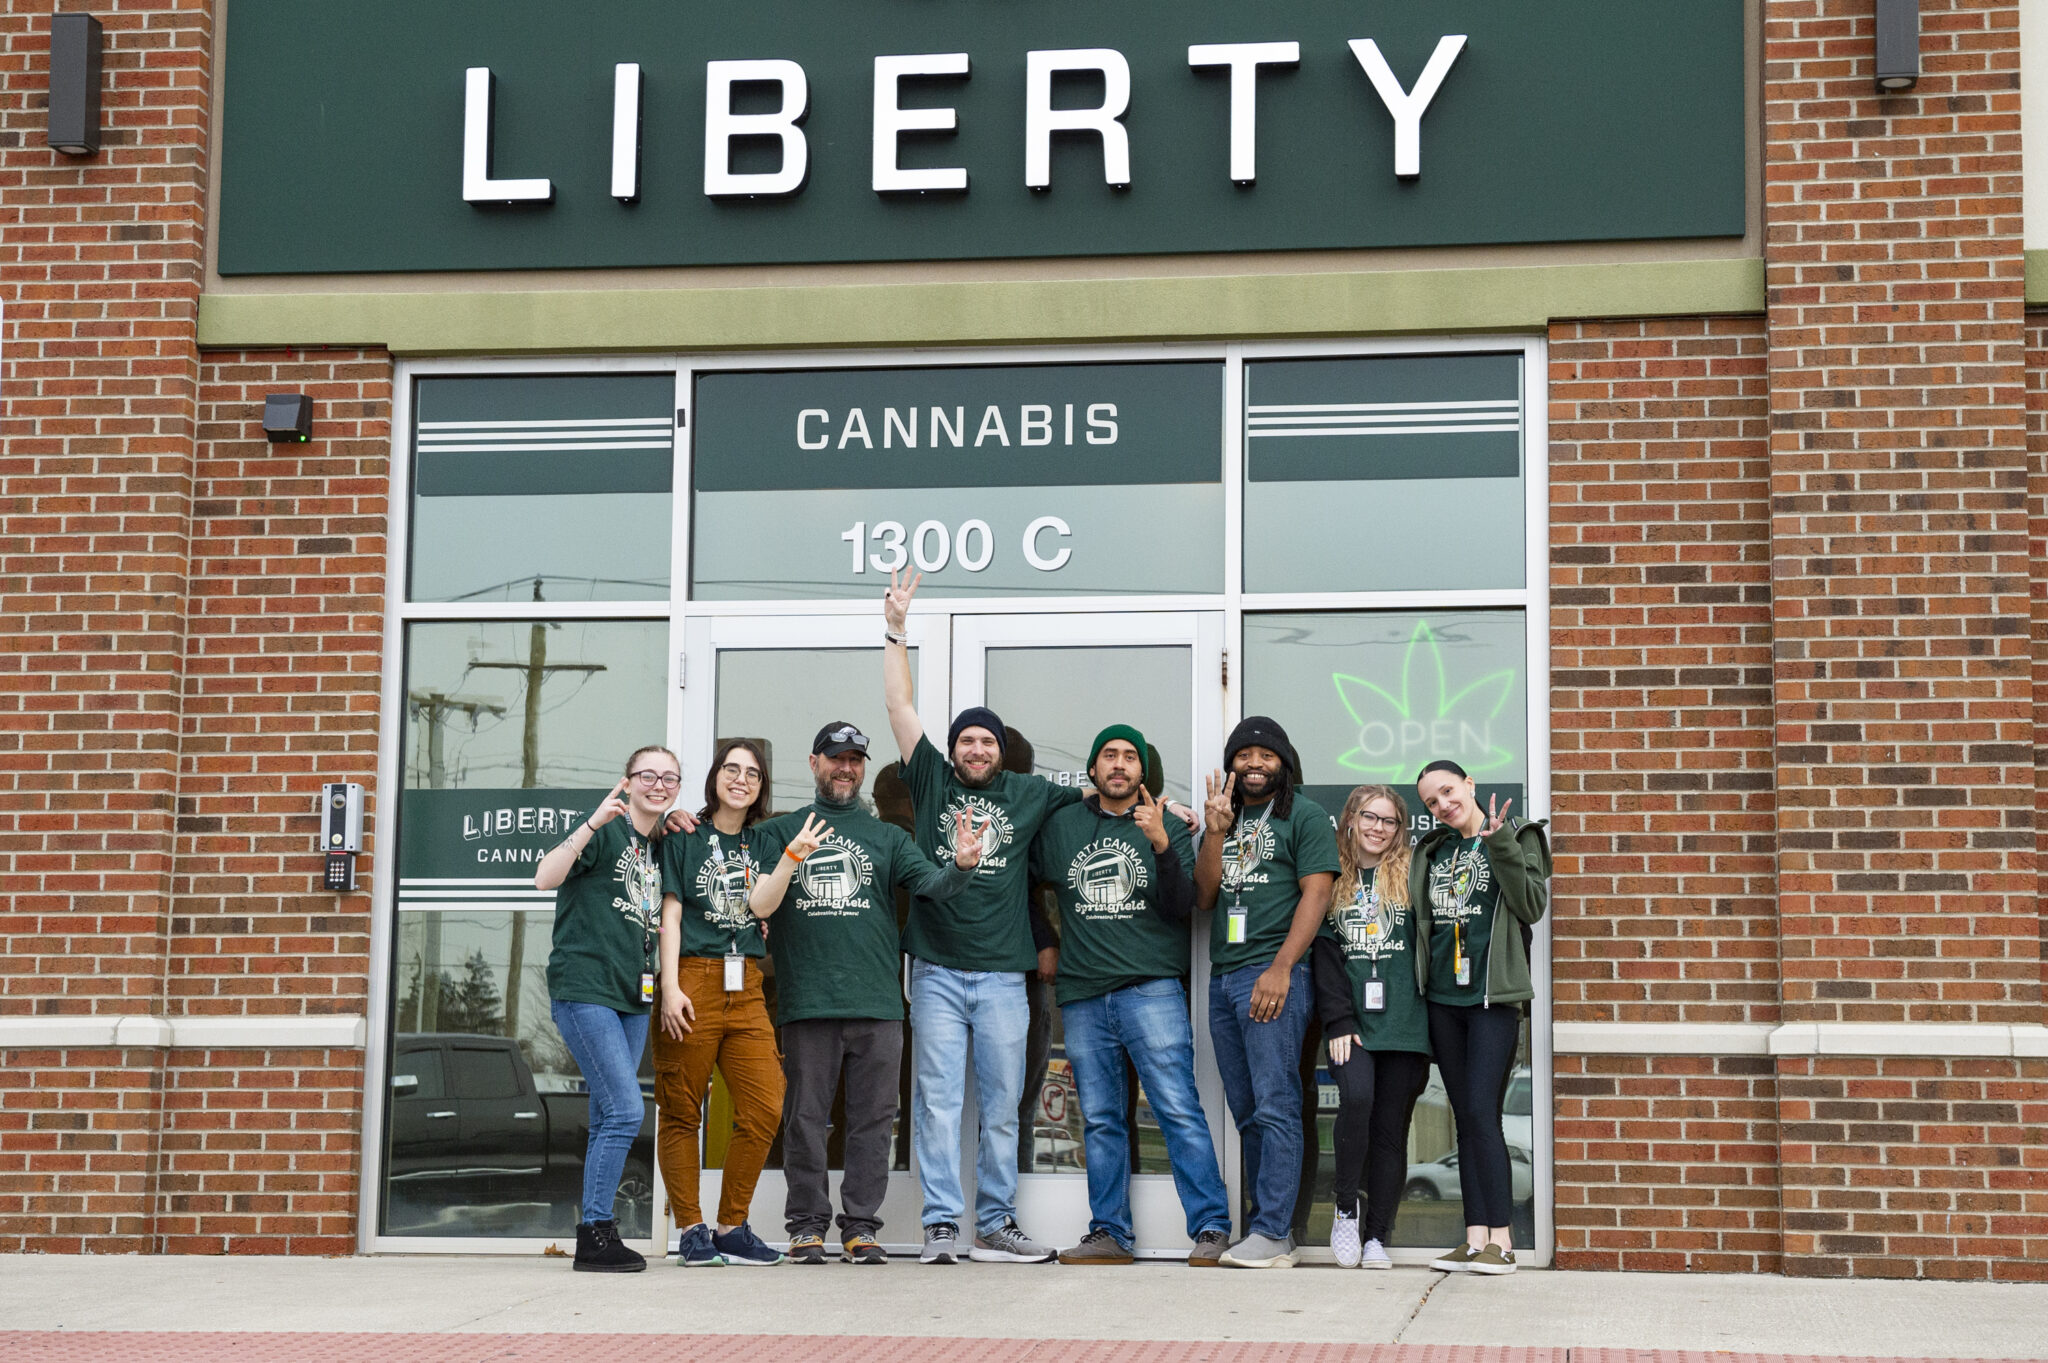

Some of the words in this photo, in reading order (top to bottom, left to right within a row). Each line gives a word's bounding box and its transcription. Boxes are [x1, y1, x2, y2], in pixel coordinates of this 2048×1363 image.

[463, 34, 1469, 203] LIBERTY
[796, 402, 1119, 450] CANNABIS
[841, 519, 995, 574] 1300
[1022, 516, 1073, 572] C
[1359, 719, 1491, 757] OPEN
[462, 807, 585, 841] LIBERT
[968, 795, 1015, 845] CANNABIS
[477, 848, 545, 863] CANNA
[825, 833, 874, 887] CANNABIS
[1067, 839, 1100, 890] LIBERTY
[1102, 837, 1149, 889] CANNABIS
[795, 895, 871, 911] Springfield
[1074, 899, 1147, 915] Springfield
